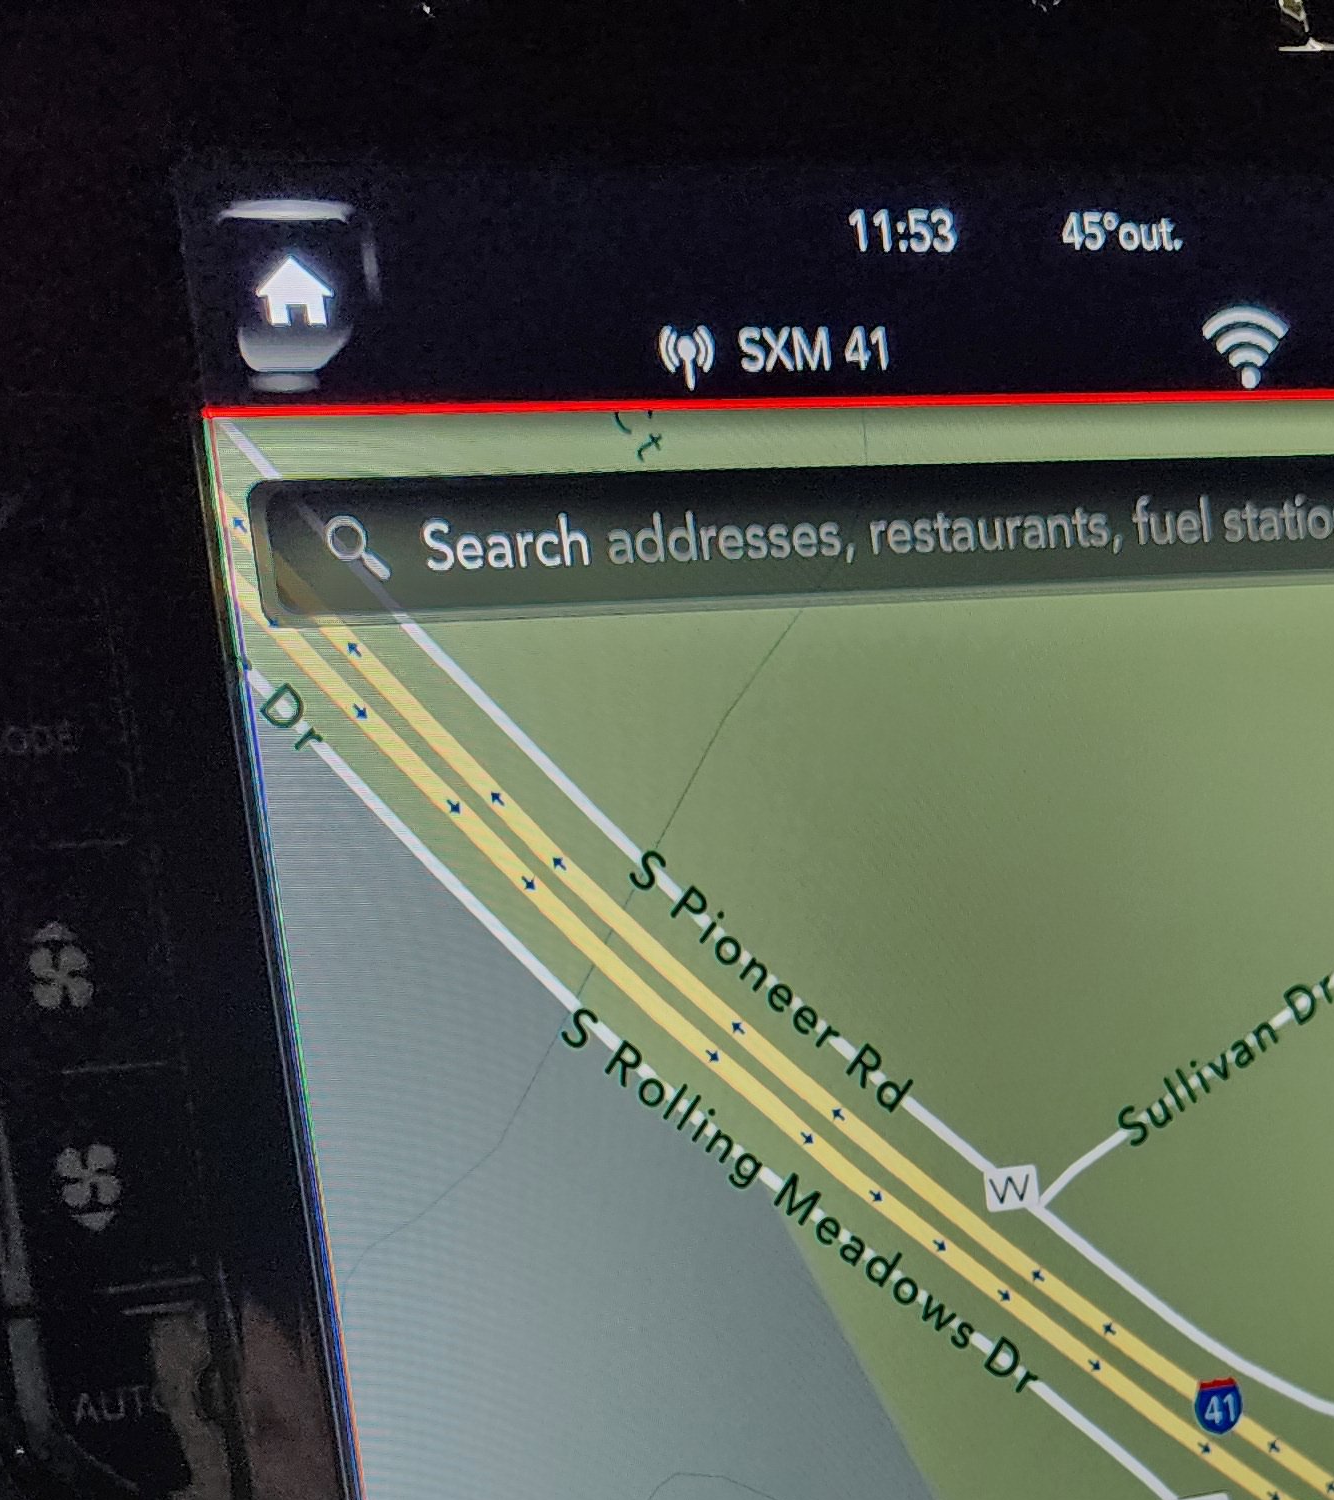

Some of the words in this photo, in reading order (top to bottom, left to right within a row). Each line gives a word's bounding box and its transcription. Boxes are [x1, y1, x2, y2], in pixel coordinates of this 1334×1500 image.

[849, 208, 958, 255] 11:53
[739, 326, 831, 373] SXM
[844, 325, 890, 371] 41
[422, 512, 591, 572] Search
[608, 511, 855, 565] addresses,
[869, 504, 1123, 556] restaurants,
[1132, 495, 1212, 545] fuel
[260, 683, 323, 751] Dr
[629, 850, 666, 890] S
[670, 885, 841, 1048] Pioneer
[845, 1043, 913, 1112] Rd
[1117, 1020, 1279, 1146] Sullivan
[1282, 975, 1333, 1024] Dr
[561, 1008, 598, 1048] S
[604, 1040, 763, 1189] Rolling
[773, 1172, 974, 1349] Meadows
[984, 1336, 1038, 1393] Dr
[1204, 1394, 1238, 1424] 41
